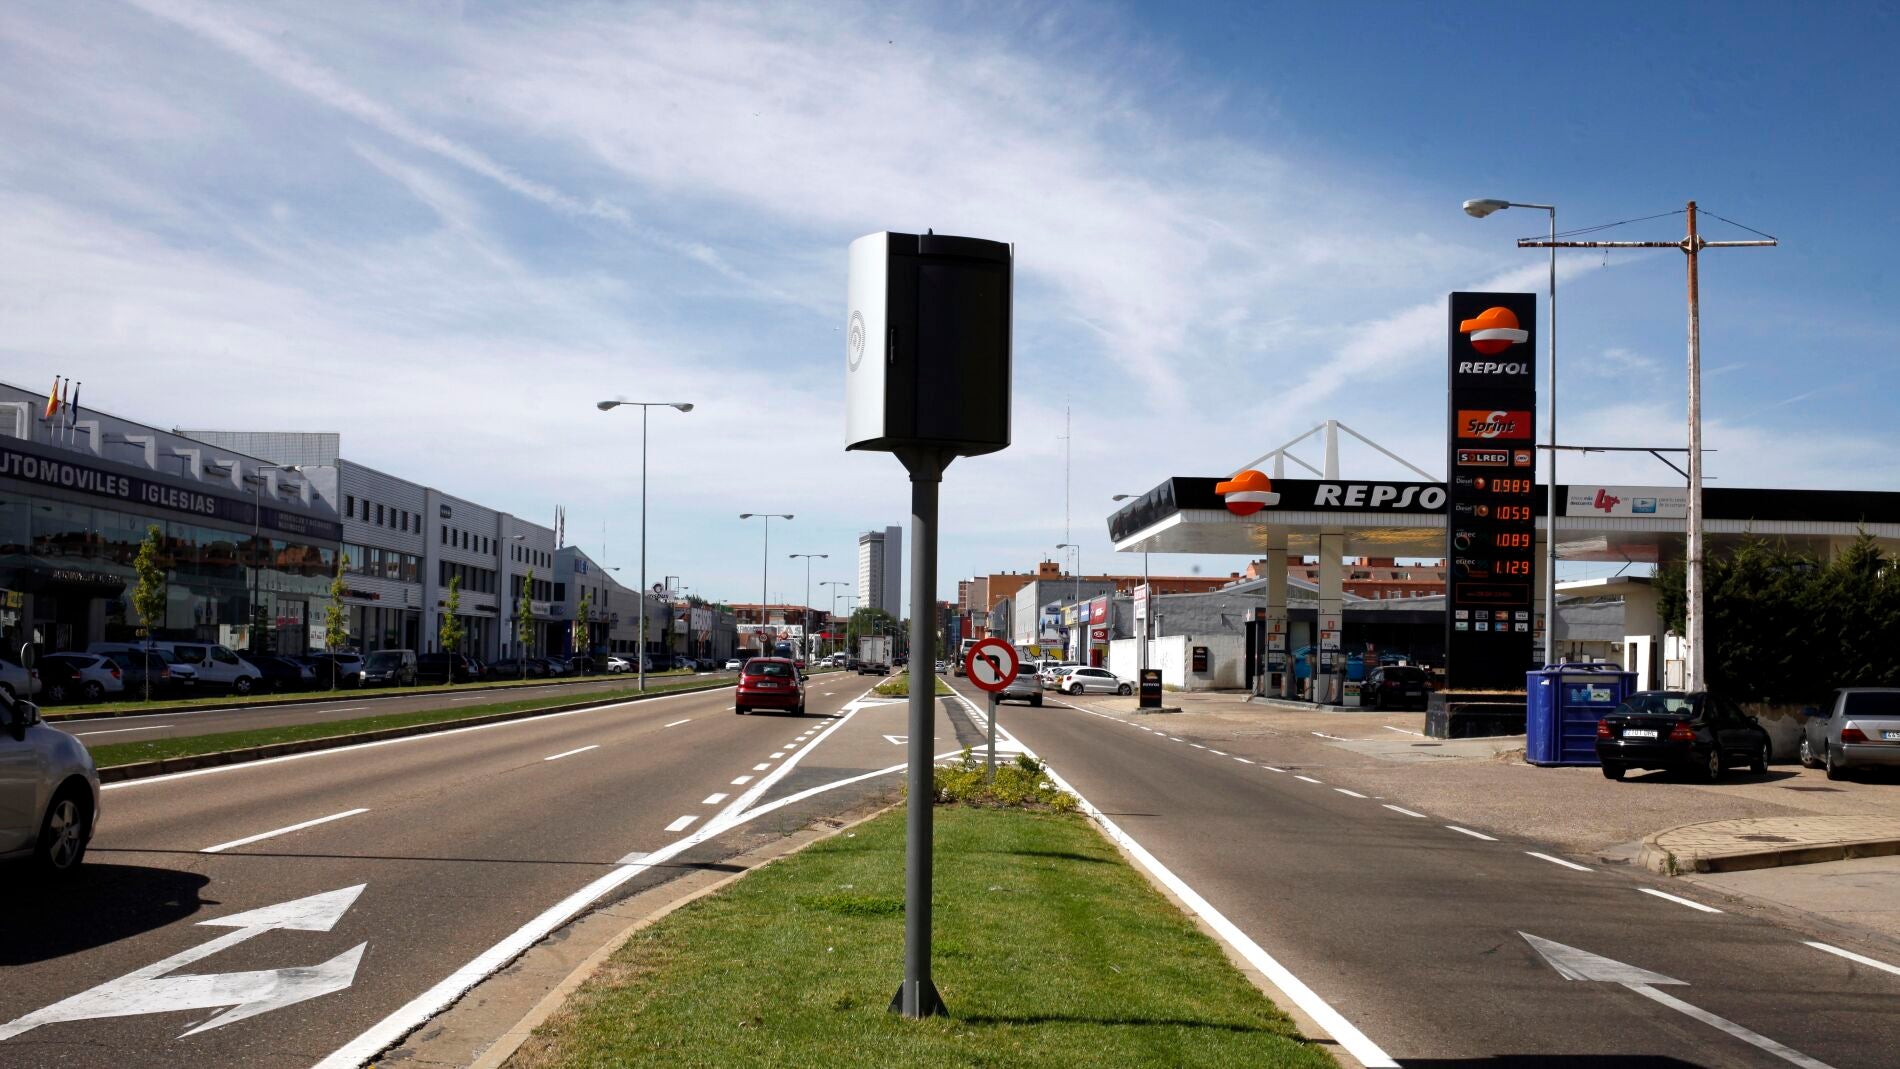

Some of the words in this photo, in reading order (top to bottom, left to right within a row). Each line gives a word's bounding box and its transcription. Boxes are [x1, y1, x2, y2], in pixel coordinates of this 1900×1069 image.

[1459, 361, 1529, 375] REPSOL
[1467, 418, 1516, 437] Sprint
[1461, 453, 1506, 462] SOLRED
[0, 452, 129, 497] UTOMOVILES
[142, 483, 215, 514] IGLESIAS
[1492, 479, 1530, 493] 0.989
[1314, 483, 1447, 509] REPSO
[1496, 506, 1530, 520] 1.059
[1496, 533, 1530, 547] 1.089
[1496, 561, 1530, 575] 1.129
